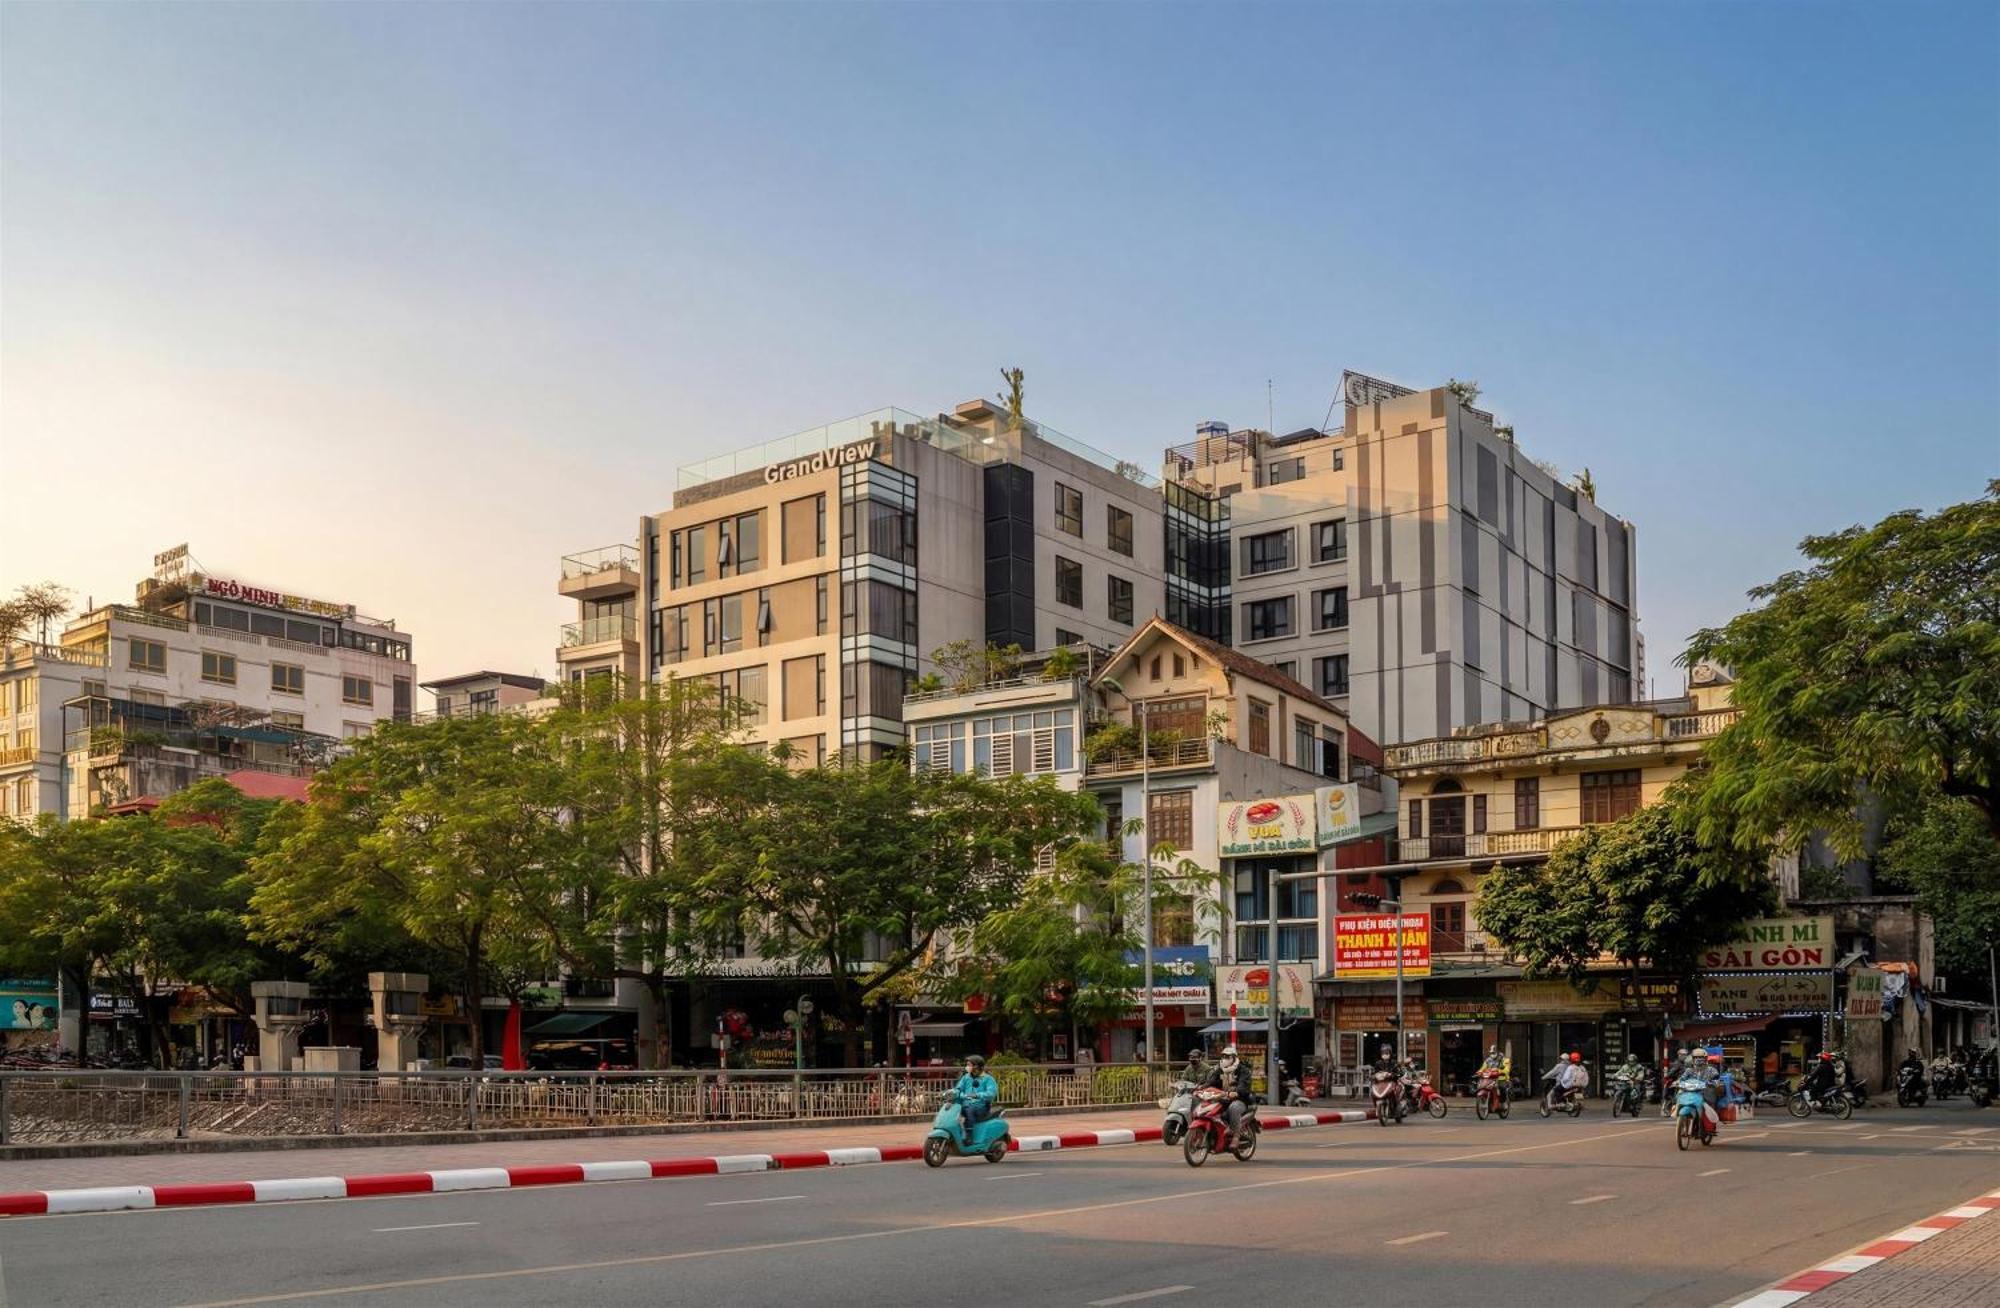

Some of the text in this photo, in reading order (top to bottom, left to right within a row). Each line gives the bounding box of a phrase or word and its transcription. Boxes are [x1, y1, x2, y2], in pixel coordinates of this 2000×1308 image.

[765, 442, 876, 485] GrandView
[207, 578, 280, 606] NGÔ MINH
[1340, 921, 1356, 932] PHỤ
[1337, 933, 1385, 949] THANH
[1761, 944, 1823, 966] GÒN
